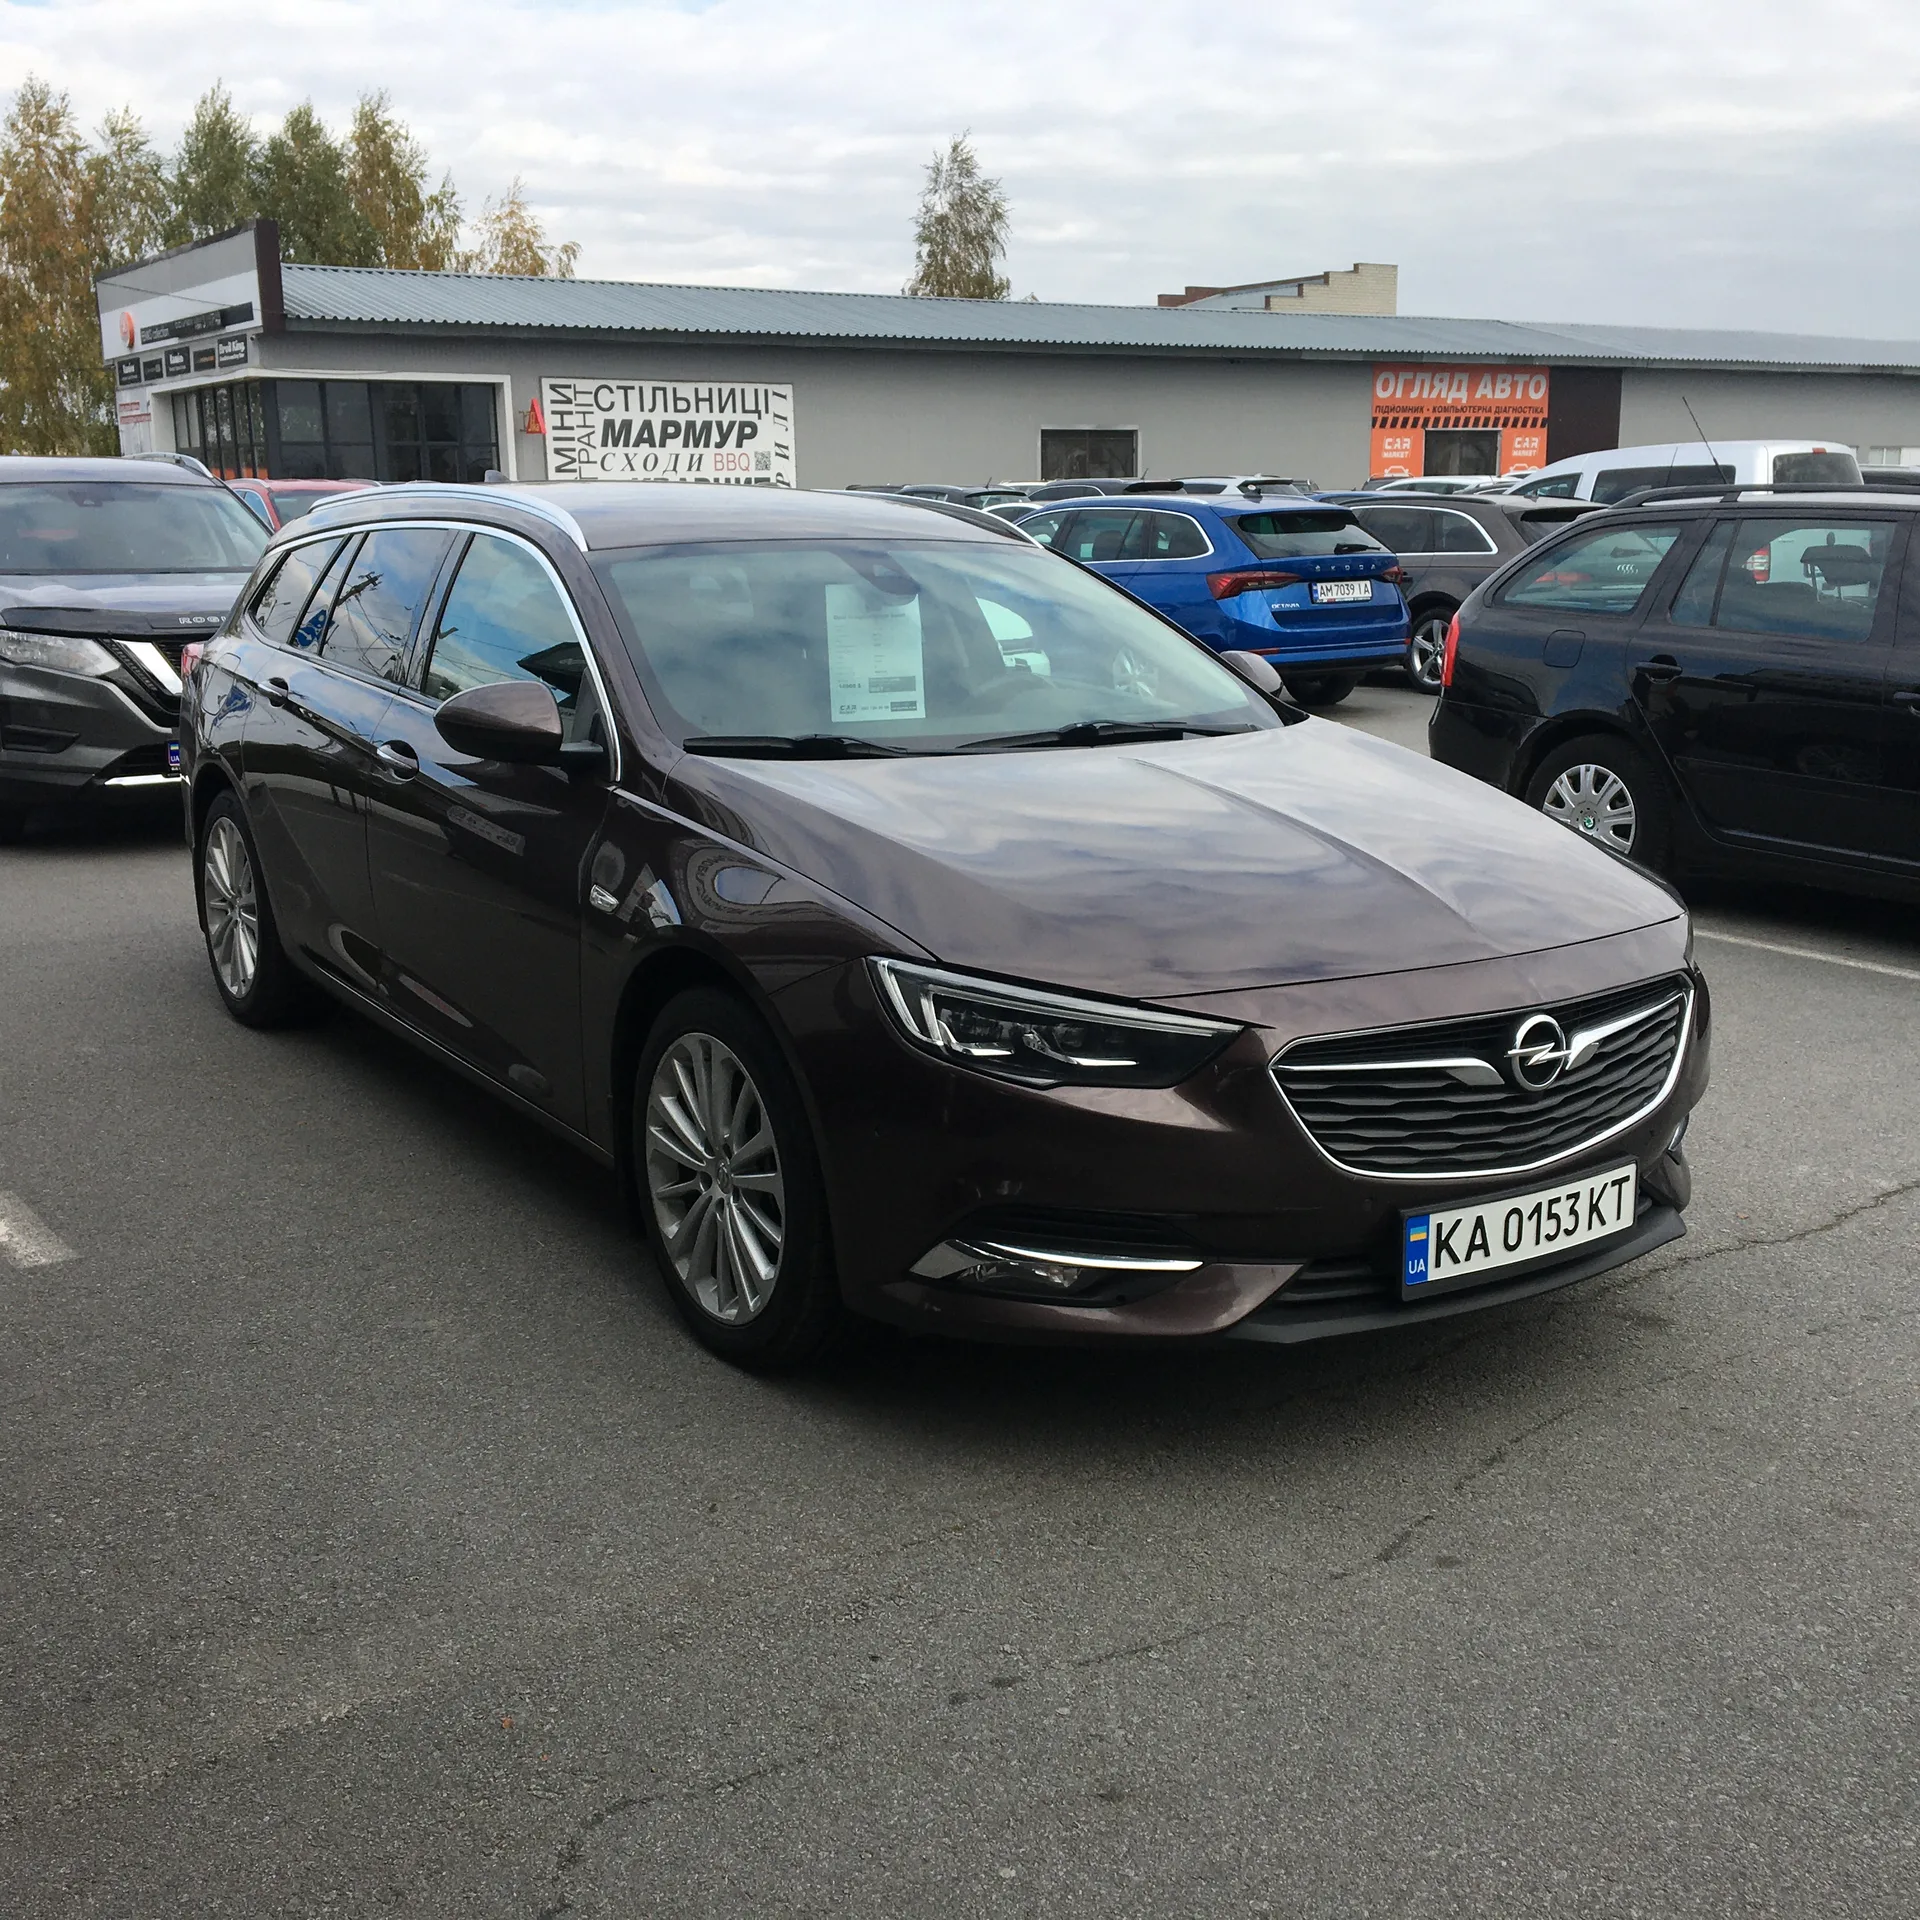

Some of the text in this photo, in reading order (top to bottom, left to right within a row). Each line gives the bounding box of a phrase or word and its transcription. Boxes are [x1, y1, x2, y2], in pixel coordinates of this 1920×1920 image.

[1375, 372, 1547, 403] ОГЛЯД АВТО
[594, 384, 769, 420] СТІЛЬНИЦІ
[1375, 405, 1424, 414] ПІДЙОМНИК
[549, 384, 578, 479] МІНИ
[601, 418, 758, 449] МАРМУР
[1514, 436, 1539, 449] CAR
[1384, 437, 1411, 450] CAR
[600, 452, 704, 476] СХОДИ
[714, 452, 750, 472] BBQ
[1320, 585, 1334, 597] AM
[1334, 584, 1355, 596] 7039
[1435, 1175, 1630, 1268] KA 0153 KT
[1409, 1259, 1426, 1274] UA
